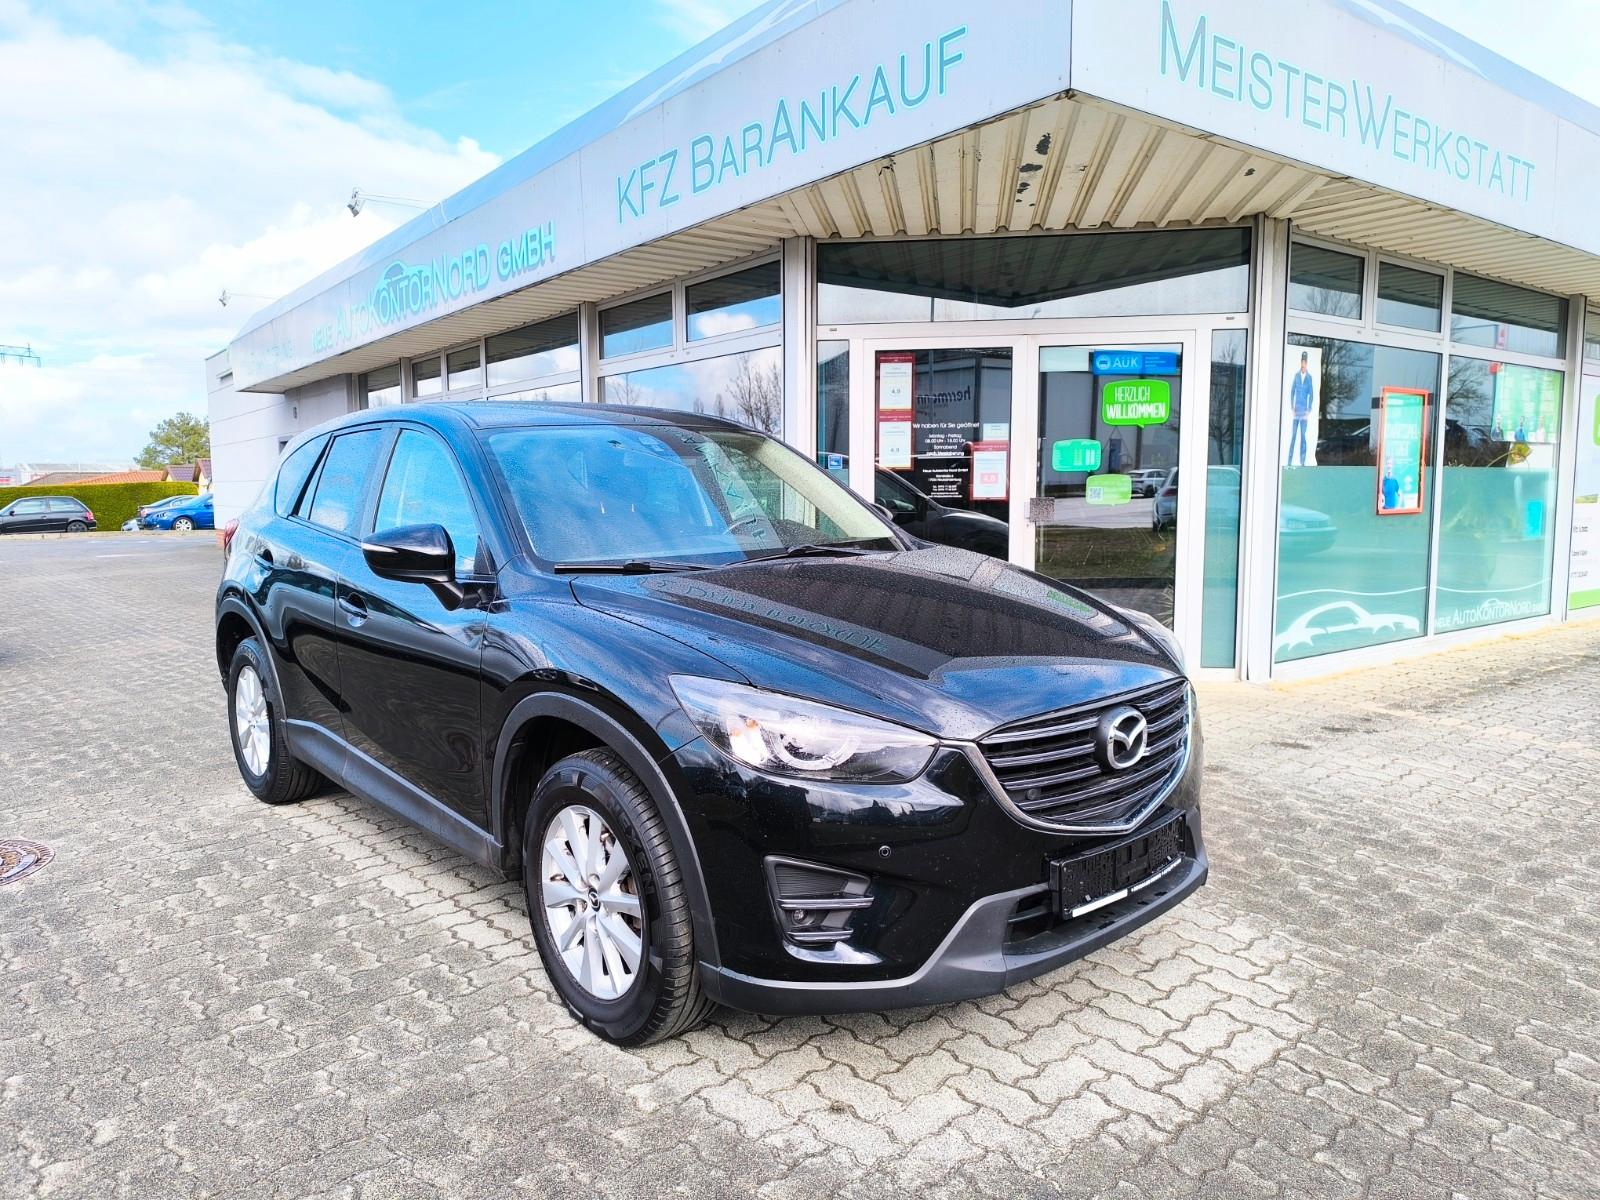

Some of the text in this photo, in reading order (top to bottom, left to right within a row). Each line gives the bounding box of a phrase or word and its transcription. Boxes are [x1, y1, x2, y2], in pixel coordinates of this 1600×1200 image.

[1158, 0, 1536, 203] MEISTERWERKSTATT
[616, 149, 680, 224] KFZ
[1106, 402, 1166, 419] WILLKOMMEN
[1114, 385, 1151, 403] HERZLICH
